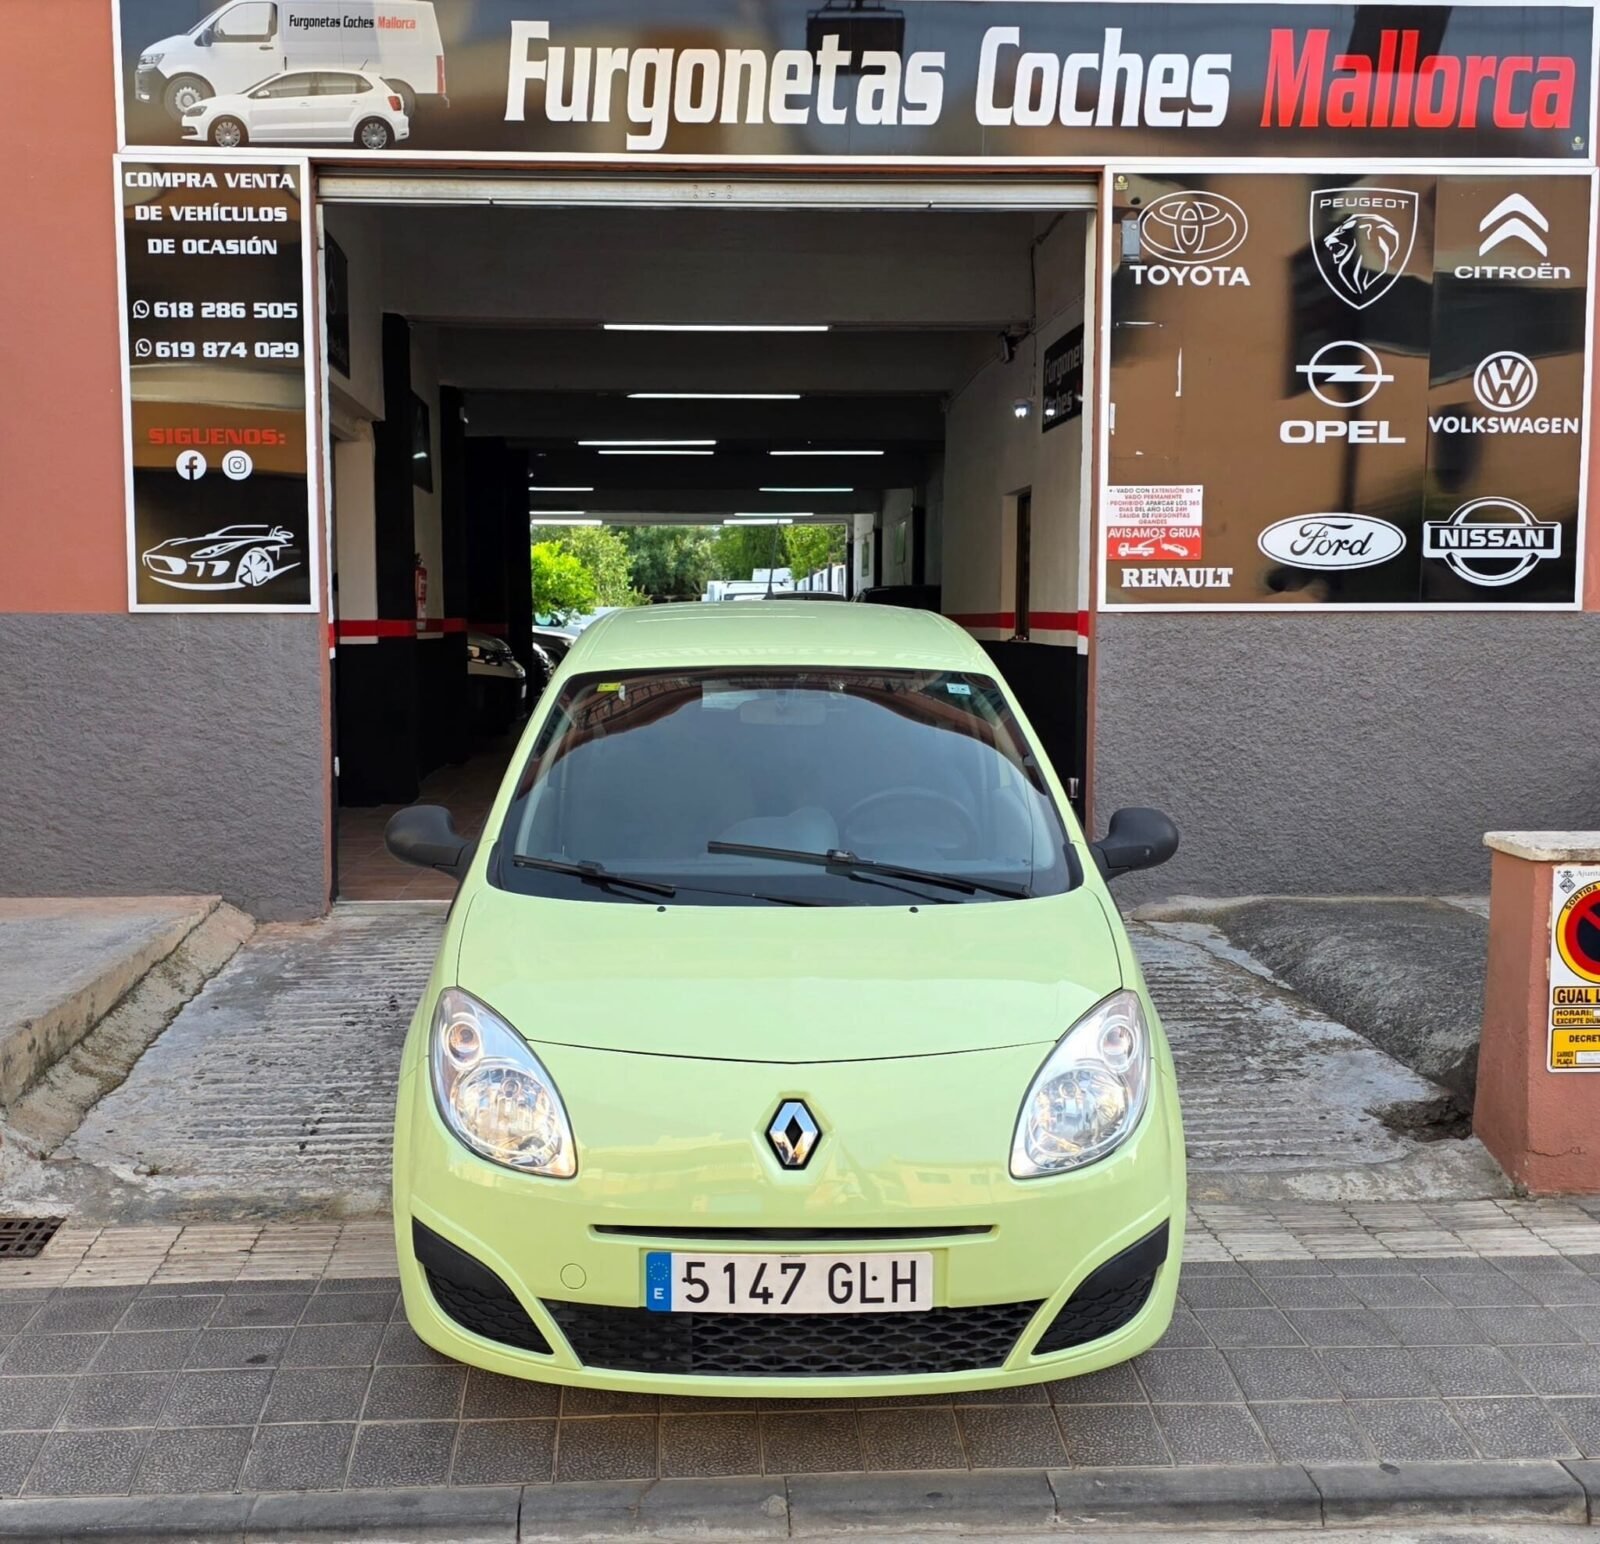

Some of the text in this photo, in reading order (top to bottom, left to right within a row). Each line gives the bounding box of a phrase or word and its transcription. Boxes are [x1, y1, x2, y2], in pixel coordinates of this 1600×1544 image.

[289, 14, 416, 31] Furgonetas Coches Mallorca
[504, 20, 1576, 151] Furgonetas Coches Mallorca
[125, 172, 296, 189] COMPRA VENTA
[1320, 197, 1409, 209] PEUGEOT
[135, 203, 288, 222] DE VEHÍCULOS
[147, 236, 278, 255] DE OCASIÓN
[1129, 265, 1251, 286] TOYOTA
[153, 301, 298, 319] 618 286 505
[155, 341, 300, 358] 619 874 029
[1279, 420, 1406, 443] OPEL
[1428, 417, 1579, 434] VOLKSWAGEN
[148, 428, 286, 445] SIGUENOS:
[1108, 528, 1201, 538] AVISAMOS GRUA
[1290, 521, 1374, 556] Ford
[1439, 529, 1544, 547] NISSAN
[1121, 568, 1233, 588] RENAULT
[1565, 884, 1598, 910] SORTIDA
[1557, 988, 1591, 1004] GUAL
[653, 1260, 916, 1304] E 5147 GLH
